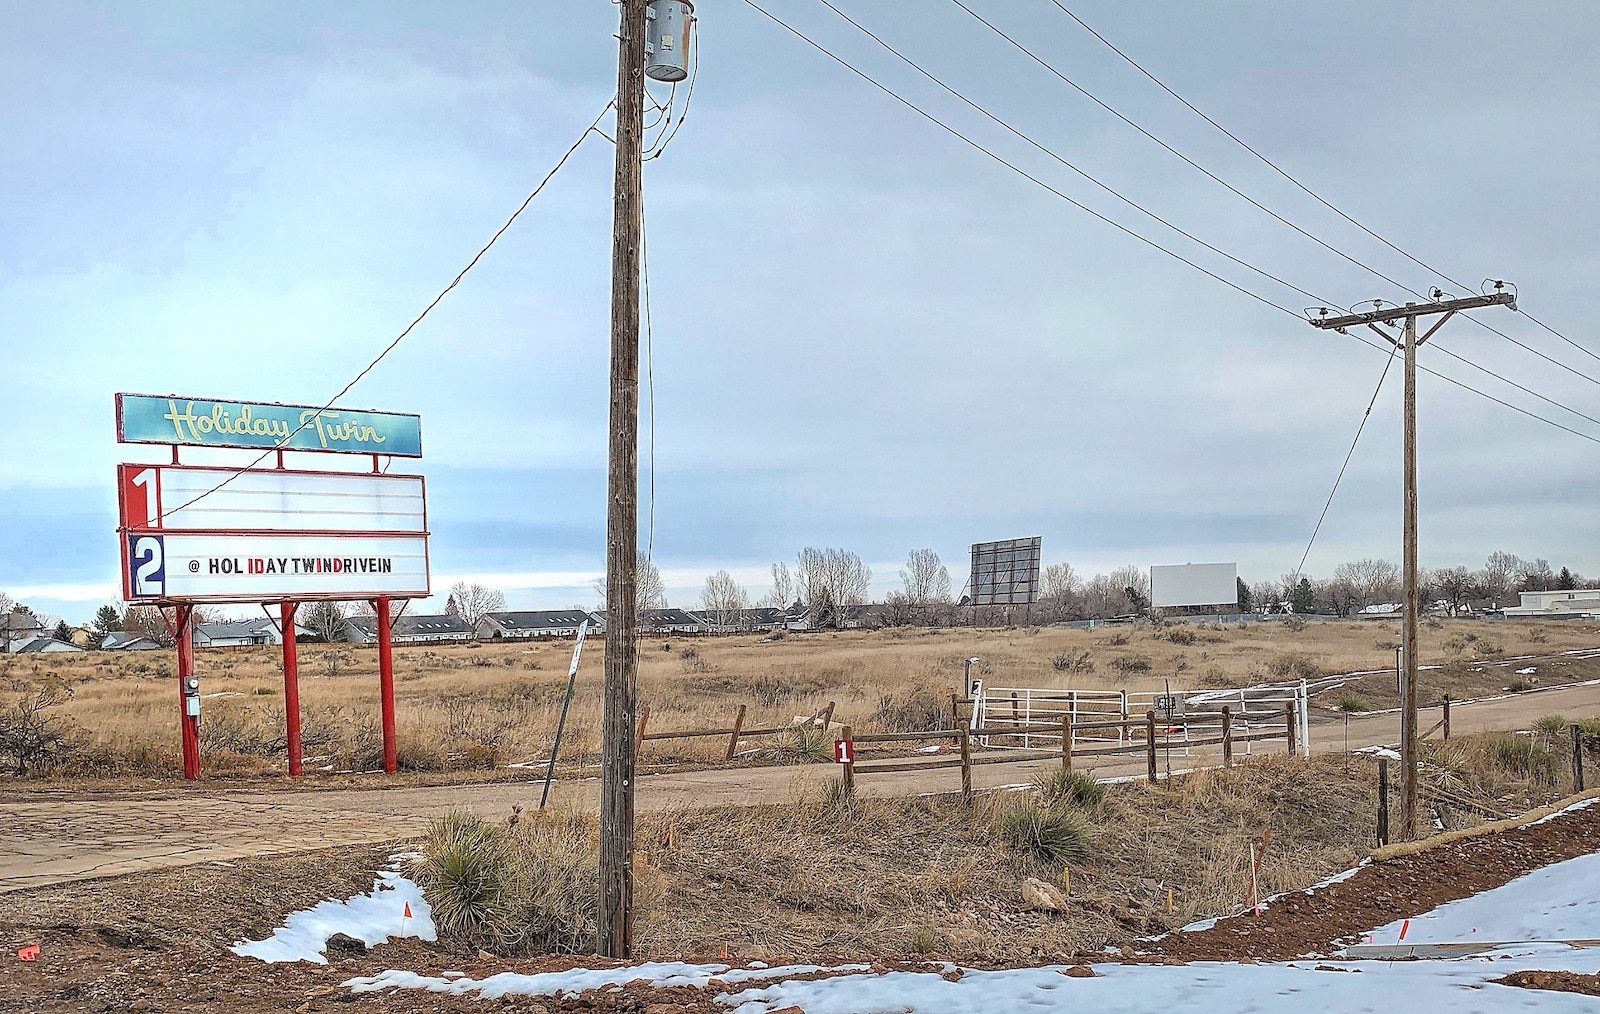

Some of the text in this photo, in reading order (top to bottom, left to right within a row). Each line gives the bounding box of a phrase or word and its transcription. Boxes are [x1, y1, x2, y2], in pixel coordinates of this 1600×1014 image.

[164, 400, 386, 448] Holiday Twin
[131, 468, 159, 528] 1
[135, 536, 162, 595] 2
[188, 560, 200, 573] @
[838, 742, 850, 762] 1
